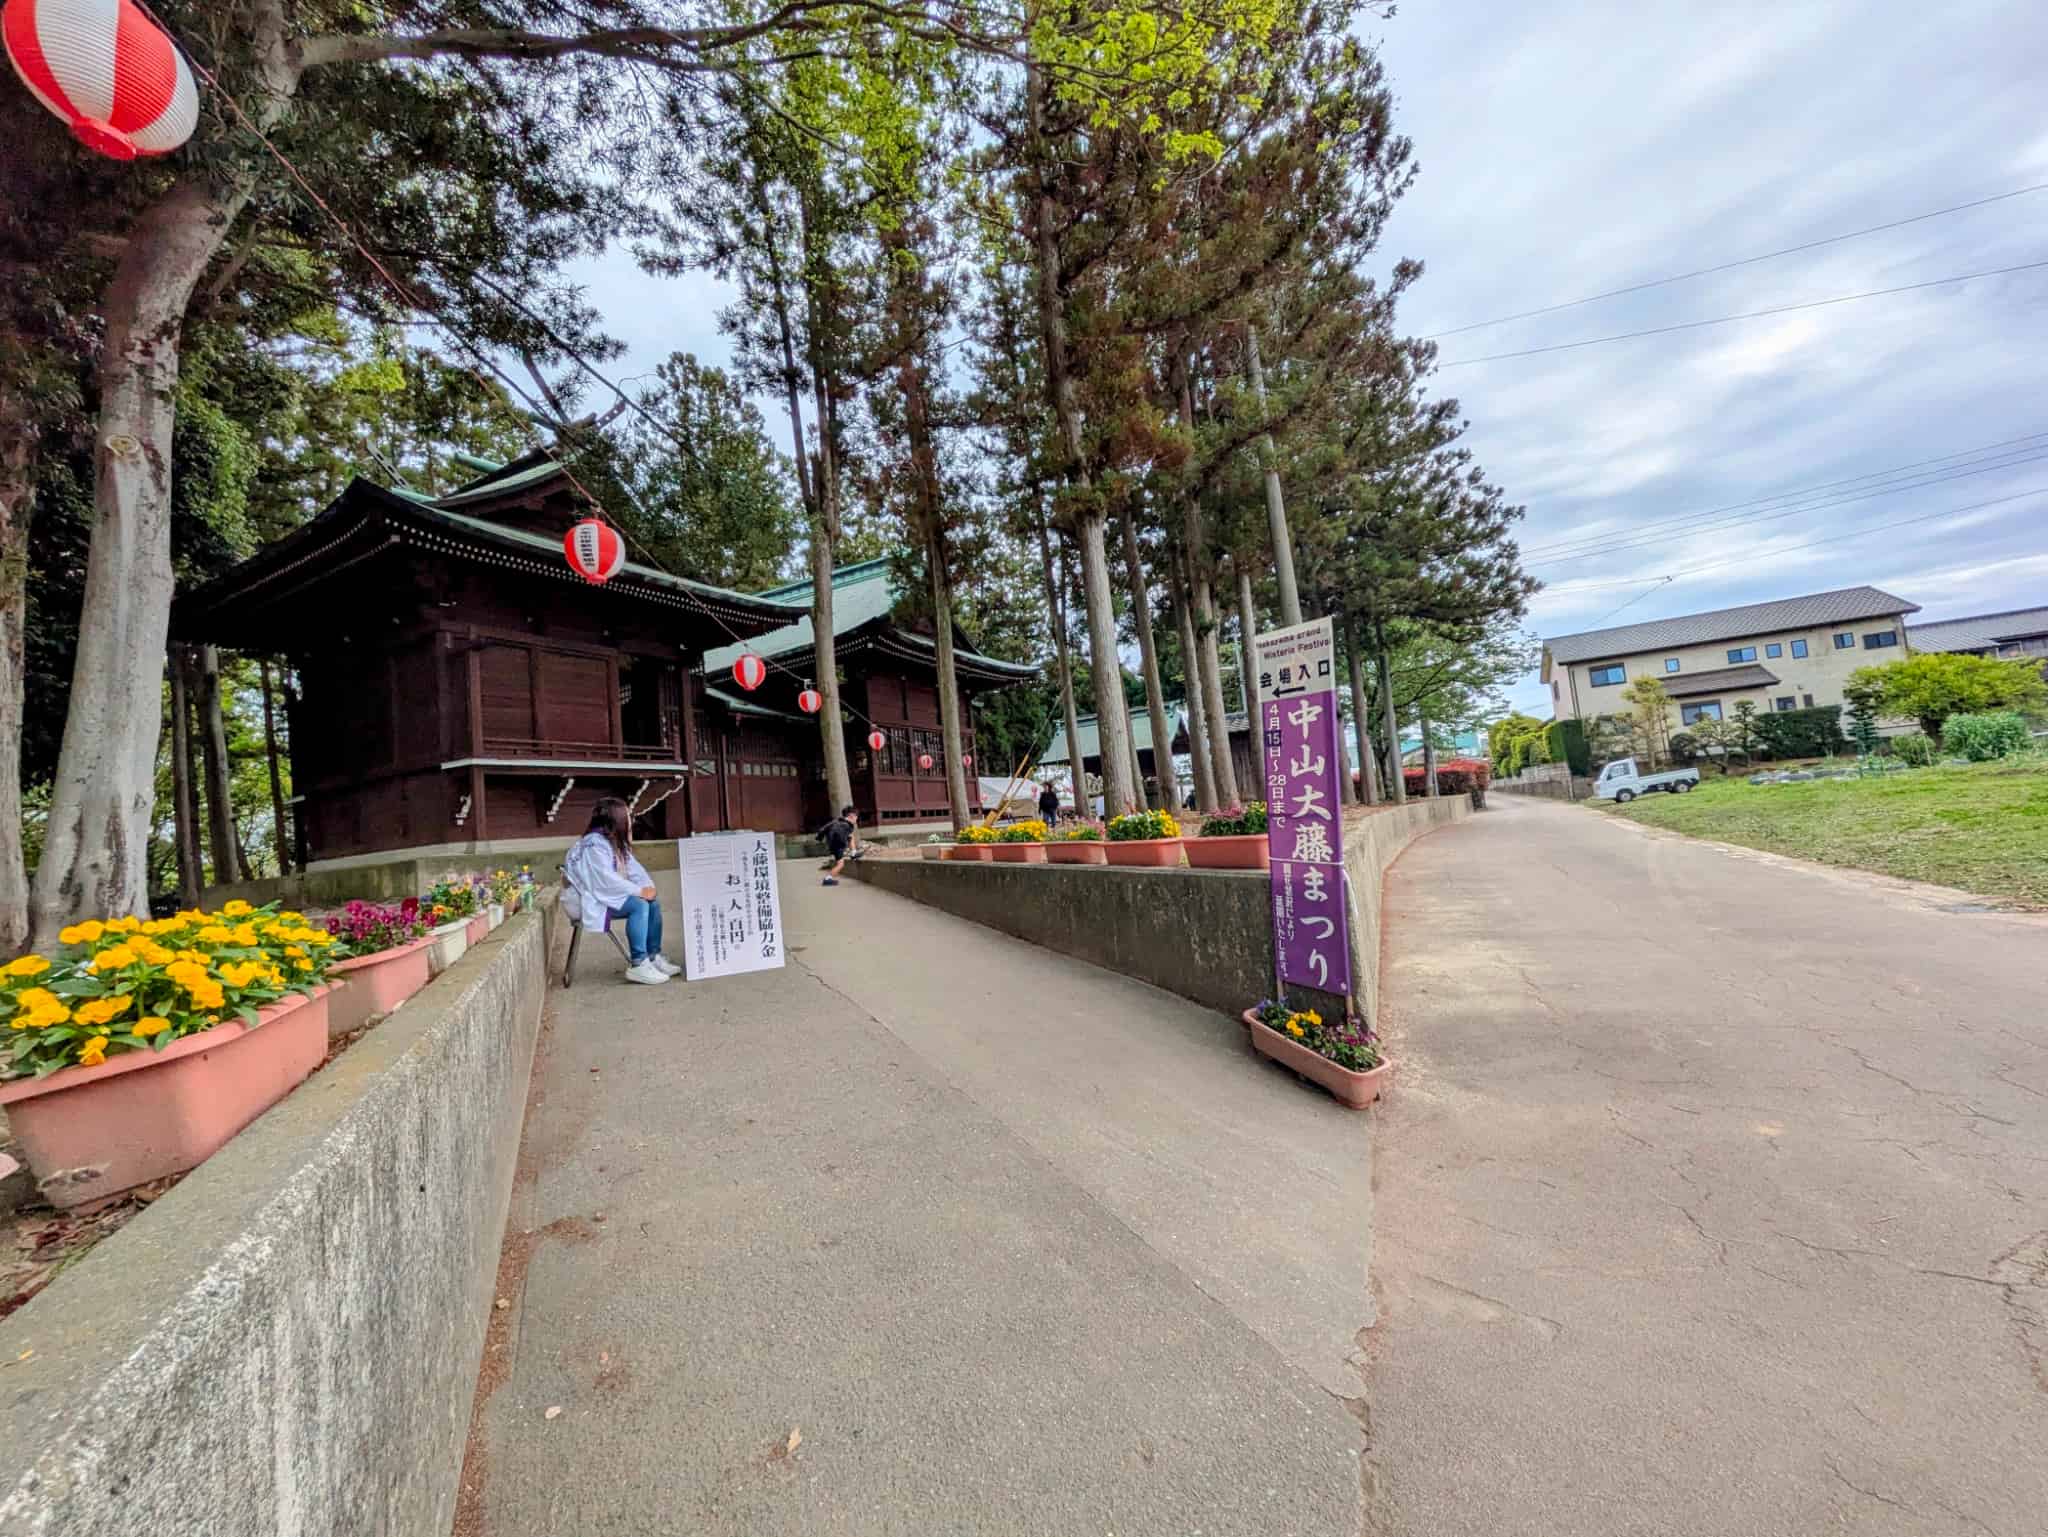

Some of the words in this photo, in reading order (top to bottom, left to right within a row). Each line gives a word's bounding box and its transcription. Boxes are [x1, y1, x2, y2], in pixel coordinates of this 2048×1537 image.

[1259, 659, 1330, 688] 会場入口
[752, 839, 776, 958] 大藤環境整備協力金
[1287, 699, 1335, 986] 中山大藤まつり
